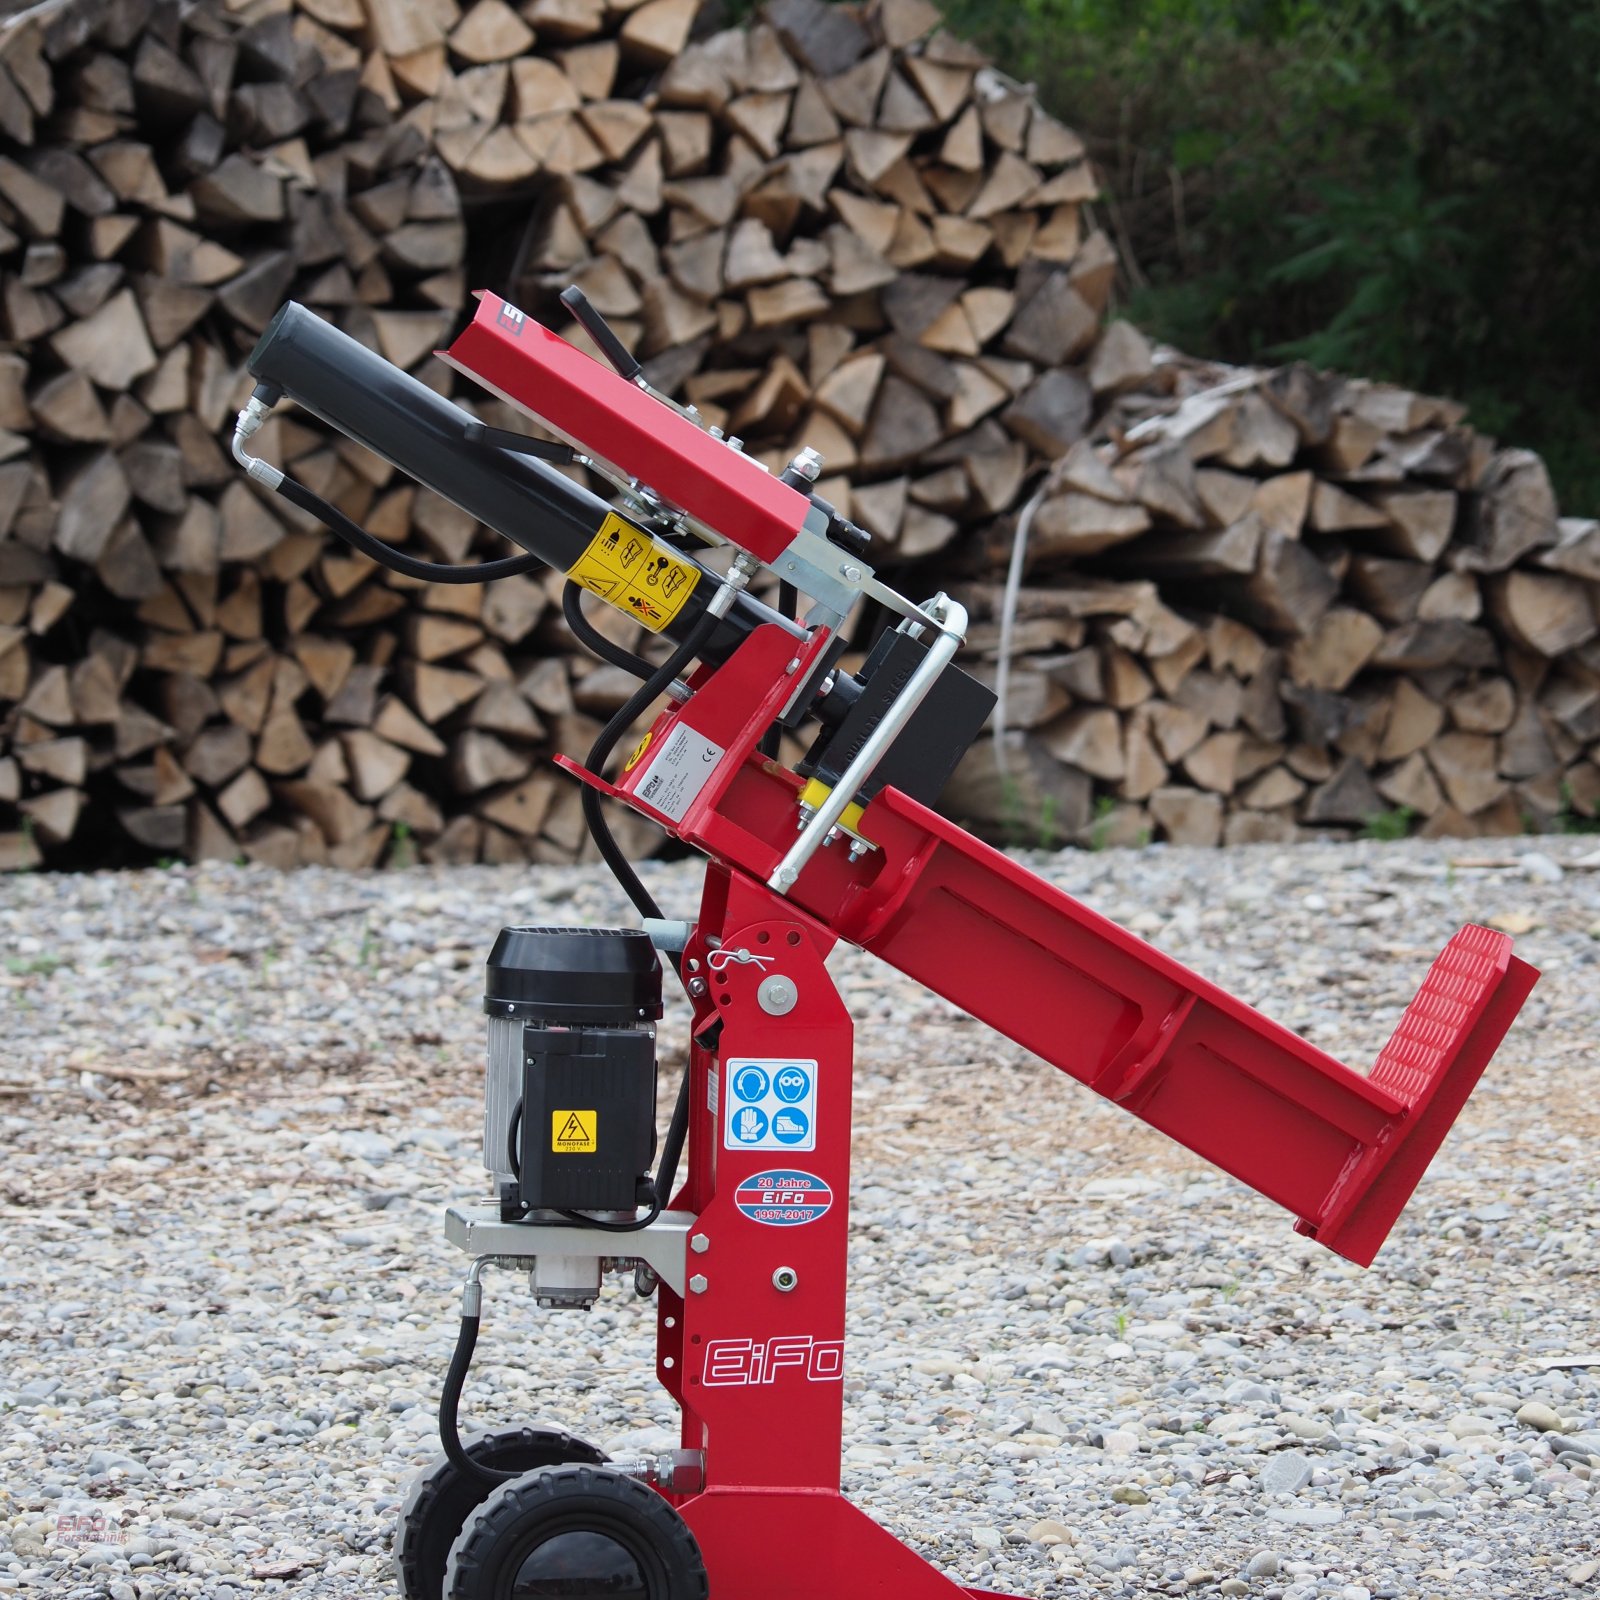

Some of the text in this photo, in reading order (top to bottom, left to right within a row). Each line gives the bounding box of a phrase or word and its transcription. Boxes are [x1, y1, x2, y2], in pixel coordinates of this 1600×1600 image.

[758, 1178, 811, 1188] 20 Jahre
[754, 1209, 814, 1220] 1997-2017
